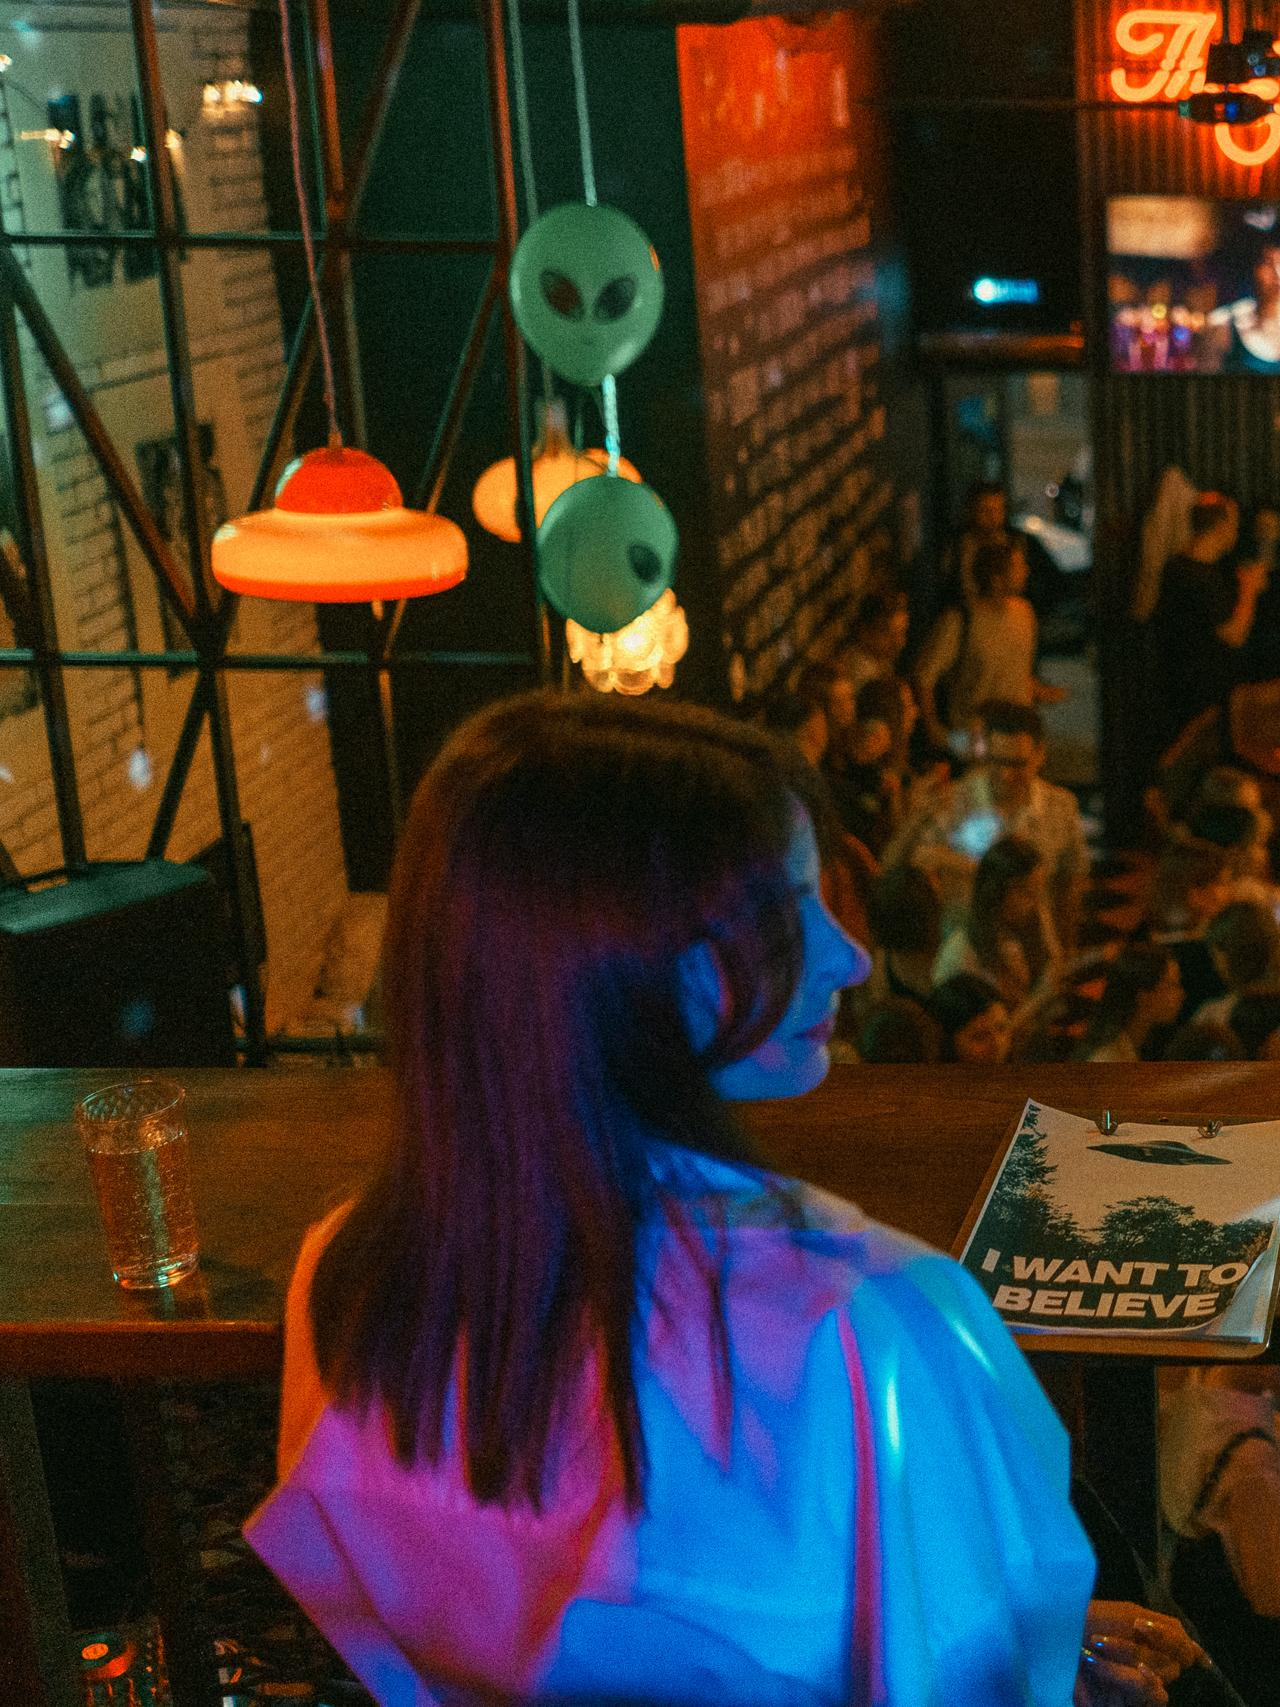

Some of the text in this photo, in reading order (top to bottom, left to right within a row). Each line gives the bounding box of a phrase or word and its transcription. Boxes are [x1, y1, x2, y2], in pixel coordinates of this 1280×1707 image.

[1110, 9, 1225, 102] Th
[983, 1248, 1249, 1287] I WANT TO
[993, 1285, 1219, 1318] BELIEVE
